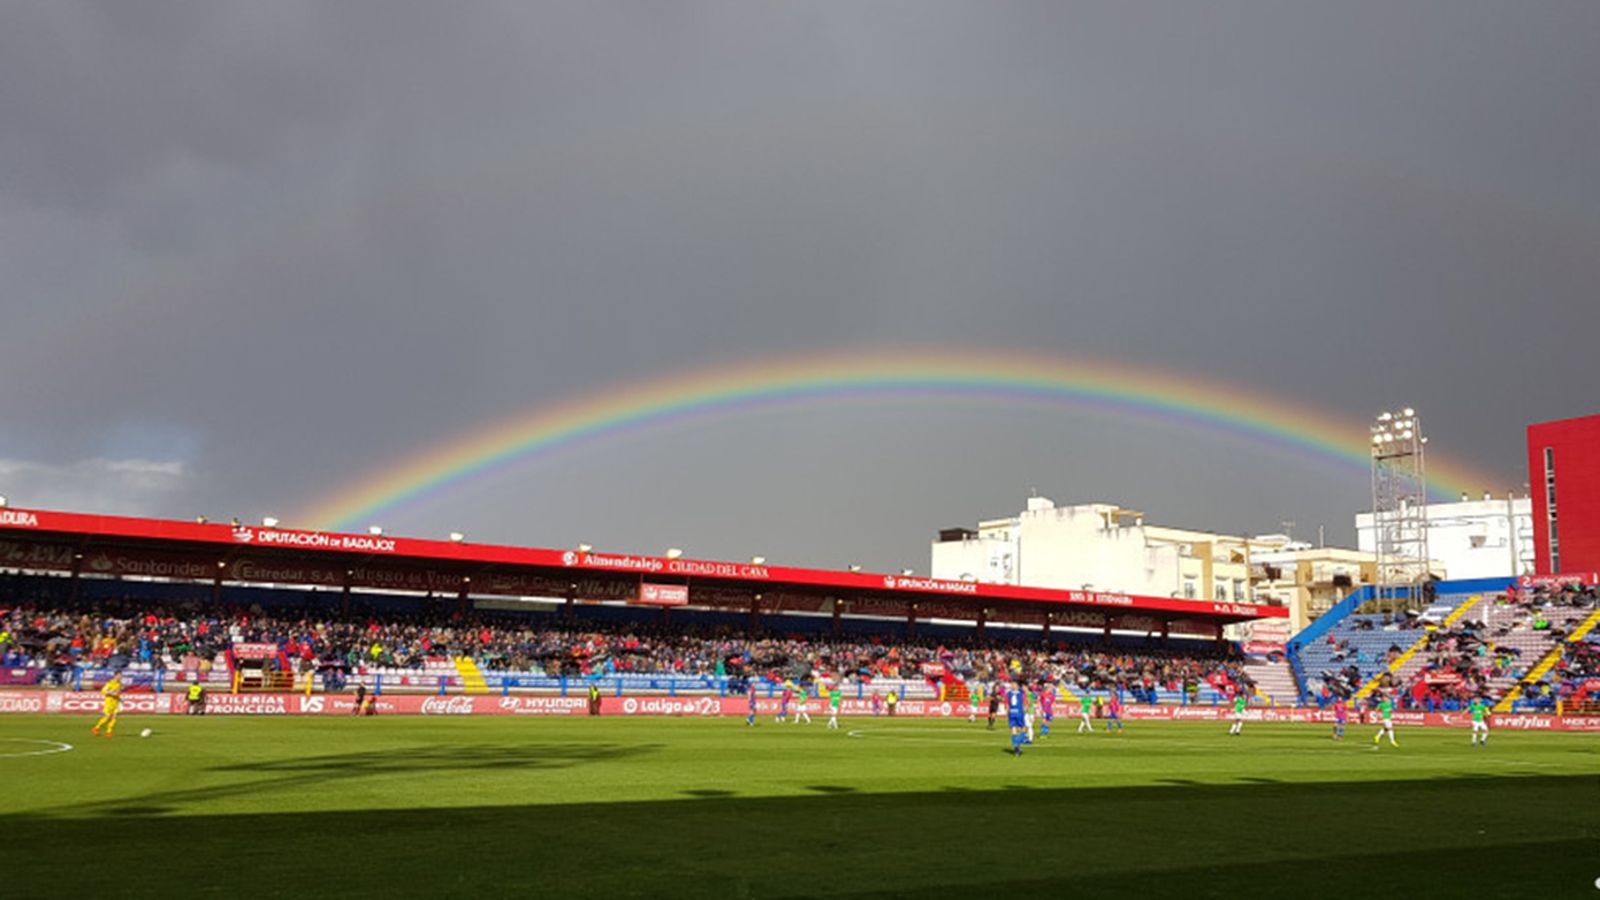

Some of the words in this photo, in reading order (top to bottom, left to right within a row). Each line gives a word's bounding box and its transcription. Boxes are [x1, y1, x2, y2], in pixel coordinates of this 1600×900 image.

[258, 529, 329, 547] DIPUTACIÓN
[342, 537, 396, 551] BADAJOZ
[117, 558, 206, 577] Santander
[583, 554, 663, 572] Almendralejo
[669, 560, 715, 575] CIUDAD
[717, 566, 739, 576] DEL
[353, 567, 403, 582] MUSEO
[300, 696, 325, 713] VS
[526, 697, 587, 709] HYUNDAI
[641, 698, 682, 713] LaLiga
